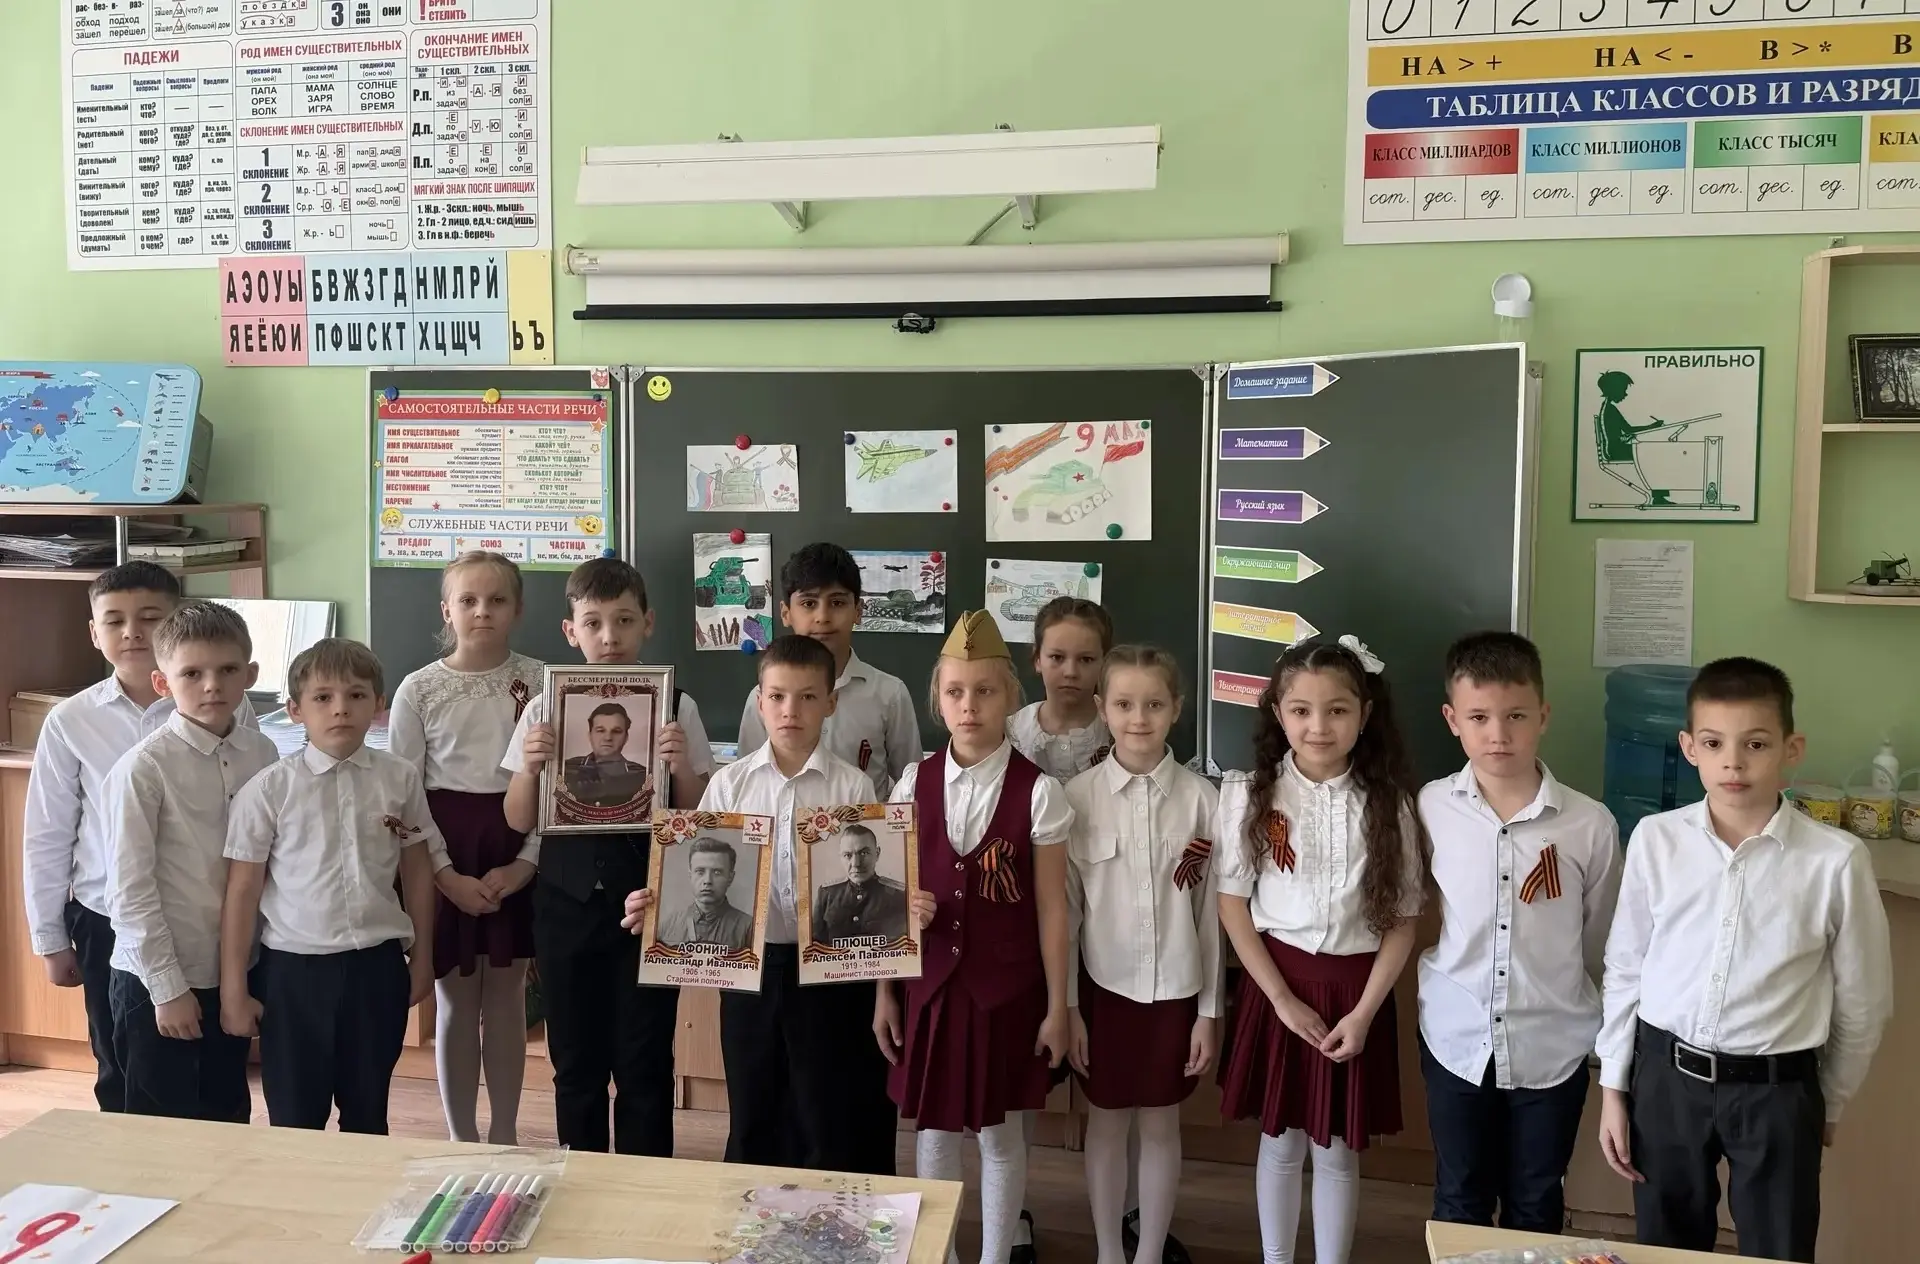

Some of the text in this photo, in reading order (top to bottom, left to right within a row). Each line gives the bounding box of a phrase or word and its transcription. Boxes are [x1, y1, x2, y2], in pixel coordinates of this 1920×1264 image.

[331, 2, 344, 27] 3
[428, 10, 466, 21] СТЕЛИТЬ
[76, 16, 140, 28] обход подход
[75, 28, 146, 40] зашел перешел
[424, 31, 523, 46] ОКОНЧАНИЕ ИМЕН
[240, 40, 402, 59] РОД ИМЕН СУЩЕСТВИТЕЛЬНЫХ
[418, 43, 530, 59] СУЩЕСТВИТЕЛЬНЫХ
[123, 49, 179, 66] ПАДЕЖИ
[1594, 46, 1642, 68] НА
[1401, 55, 1447, 77] НА
[250, 85, 277, 96] ПАПА
[305, 83, 335, 93] МАМА
[357, 80, 398, 91] СОЛНЦЕ
[251, 95, 277, 106] ОРЕХ
[307, 93, 333, 103] ЗАРЯ
[359, 90, 395, 101] СЛОВО
[412, 88, 432, 102] Р.п.
[308, 103, 333, 113] ИГРА
[360, 101, 395, 111] ВРЕМЯ
[1426, 88, 1582, 122] ТАБЛИЦА
[1591, 82, 1758, 114] КЛАССОВ
[1768, 84, 1796, 109] И
[76, 103, 129, 114] Именительный
[251, 105, 277, 116] ВОЛК
[77, 129, 124, 139] Родительный
[240, 125, 289, 138] СКЛОНЕНИЕ
[289, 124, 315, 135] ИМЕН
[315, 120, 404, 135] СУЩЕСТВИТЕЛЬНЫХ
[412, 122, 433, 137] Д.п.
[1717, 132, 1838, 152] КЛАСС ТЫСЯЧ
[1878, 131, 1920, 146] КЛА
[1372, 141, 1513, 163] КЛАСС МИЛЛИАРДОВ
[1531, 137, 1681, 158] КЛАСС МИЛЛИОНОВ
[77, 156, 117, 166] Дательный
[261, 147, 271, 167] 1
[413, 156, 433, 170] П.п.
[242, 168, 289, 179] СКЛОНЕНИЕ
[78, 181, 126, 191] Винительный
[413, 181, 535, 195] МЯГКИЙ ЗНАК ПОСЛЕ ШИПЯЩИХ
[260, 183, 272, 203] 2
[79, 207, 130, 217] Творительный
[243, 204, 290, 215] СКЛОНЕНИЕ
[496, 203, 524, 213] мышь
[262, 219, 273, 239] 3
[464, 229, 495, 241] беречь
[80, 233, 126, 243] Предложный
[244, 240, 291, 251] СКЛОНЕНИЕ
[1644, 354, 1755, 369] ПРАВИЛЬНО
[1234, 376, 1308, 389] Домашнее задание
[388, 402, 598, 415] САМОСТОЯТЕЛЬНЫЕ ЧАСТИ РЕЧИ
[402, 428, 460, 438] СУЩЕСТВИТЕЛЬНОЕ
[1074, 423, 1095, 452] 9
[386, 441, 453, 450] ИМЯ ПРИЛАГАТЕЛЬНОЕ
[1234, 437, 1289, 448] Математика
[386, 455, 409, 463] ГЛАГОЛ
[385, 469, 400, 477] ИМЯ
[401, 470, 447, 478] ЧИСЛИТЕЛЬНОЕ
[385, 483, 430, 491] МЕСТОИМЕНИЕ
[385, 497, 412, 505] НАРЕЧИЕ
[1235, 498, 1285, 514] Русский язык
[408, 517, 569, 532] СЛУЖЕБНЫЕ ЧАСТИ РЕЧИ
[397, 538, 433, 547] ПРЕДЛОГ
[480, 539, 503, 549] СОЮЗ
[549, 541, 586, 550] ЧАСТИЦА
[420, 550, 443, 558] перед
[1222, 555, 1291, 571] Окружающий мир
[833, 936, 886, 949] ПЛЮЩЕВ
[678, 944, 728, 956] АФОНИН
[647, 955, 755, 970] Александр Иванович
[812, 950, 908, 963] Алексей Павлович
[841, 962, 857, 970] 1919
[705, 969, 721, 977] 1965
[824, 968, 898, 979] Машинист паровоза
[666, 974, 734, 987] Старший политрук
